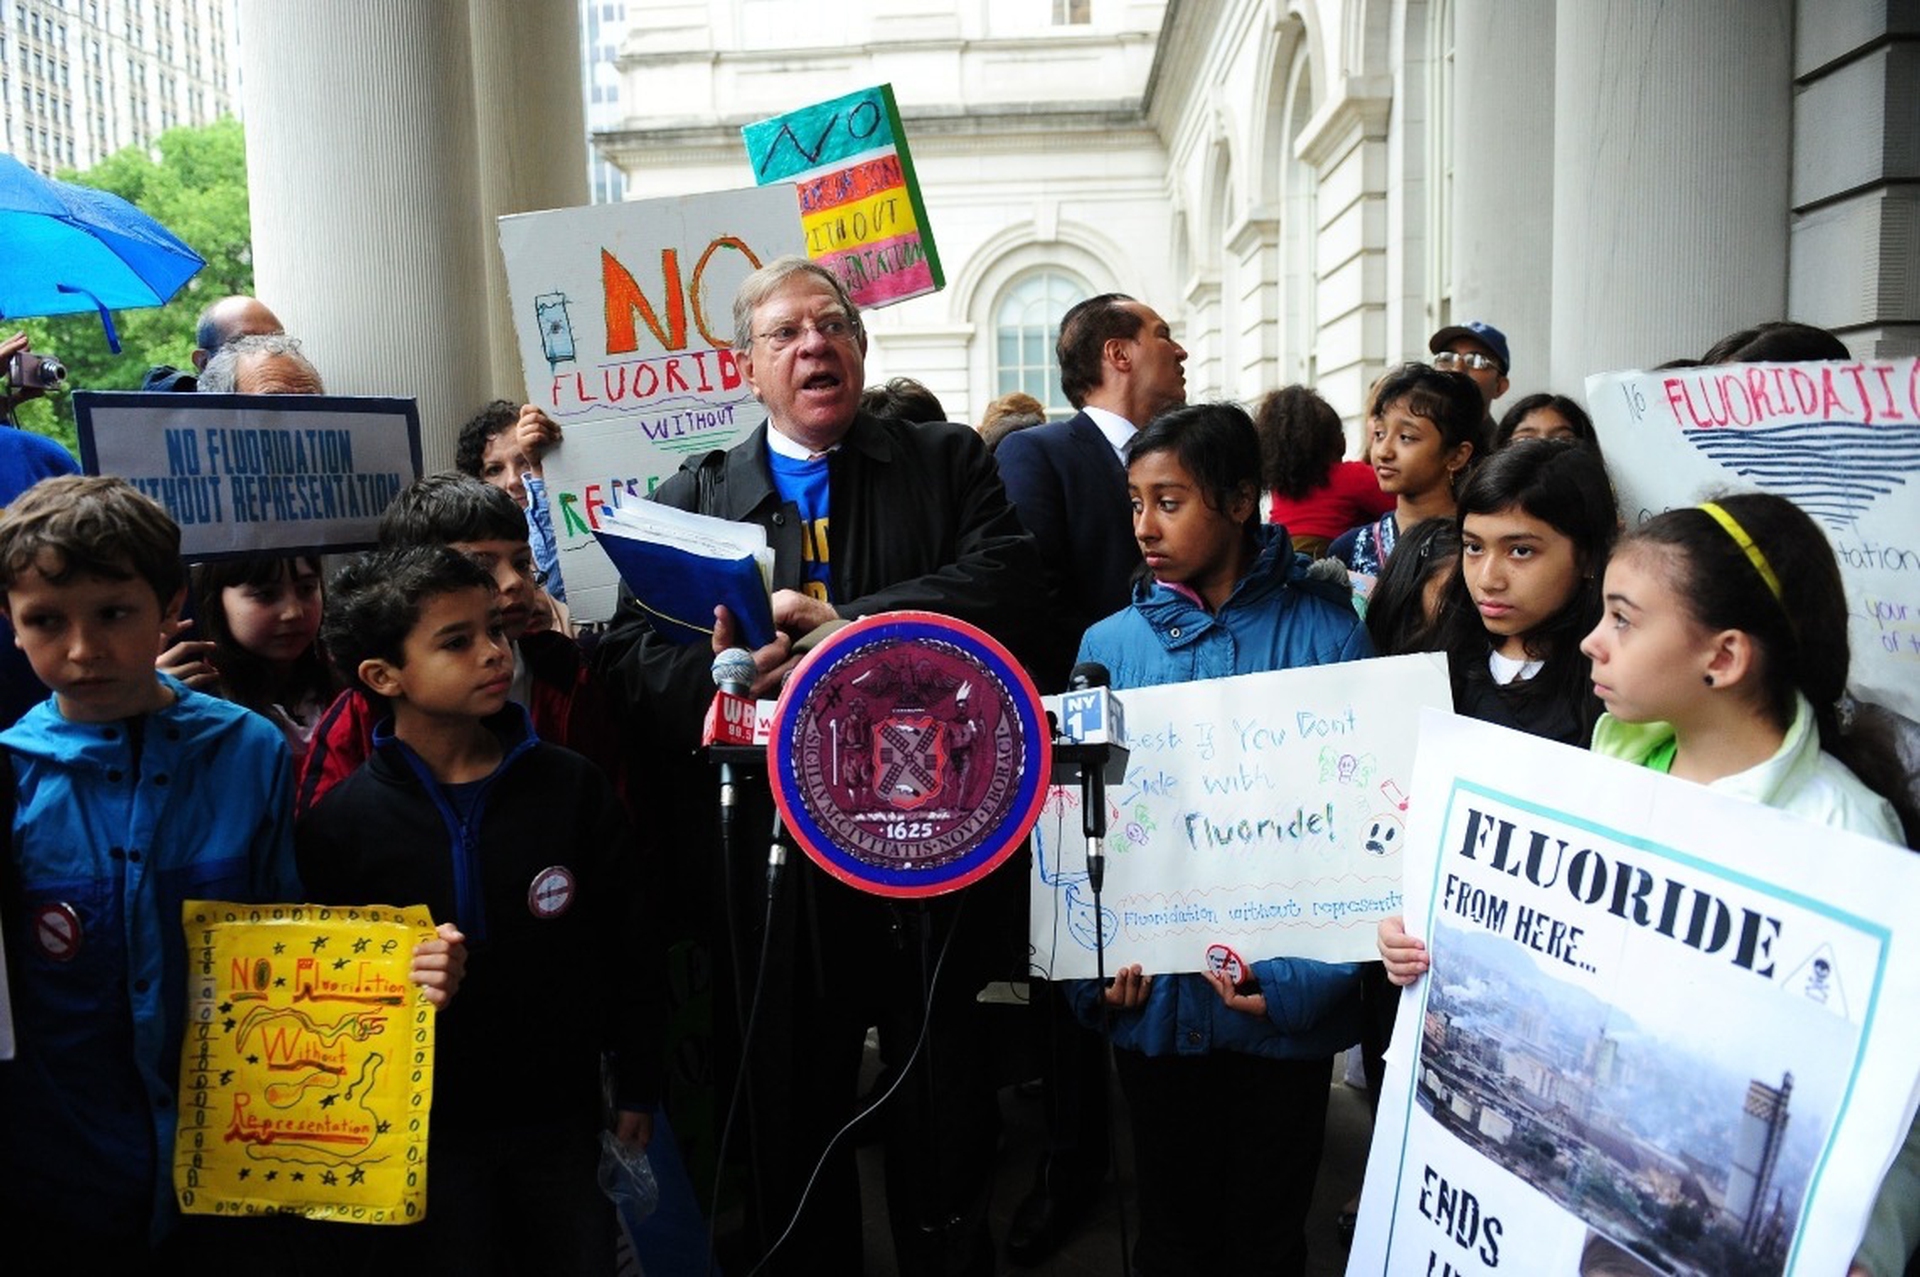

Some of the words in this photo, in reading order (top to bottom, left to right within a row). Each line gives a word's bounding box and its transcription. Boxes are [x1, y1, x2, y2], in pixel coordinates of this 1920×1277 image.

[759, 101, 882, 178] NO
[804, 198, 897, 252] ITHOUT
[601, 236, 762, 356] NO
[641, 406, 735, 440] WITHOUT
[165, 428, 198, 477] NO
[206, 428, 353, 475] FLUORIDATION
[1864, 599, 1909, 631] your
[1067, 695, 1097, 712] NY
[1067, 712, 1083, 742] 1
[804, 732, 839, 820] SIGILLVM
[837, 818, 934, 857] CIVITATIS
[937, 814, 984, 850] NOVI
[983, 731, 1014, 817] EBORACI
[1202, 763, 1276, 795] with
[886, 822, 933, 840] 1625
[1229, 899, 1302, 921] without
[1459, 808, 1783, 979] FLUORIDE
[1443, 873, 1509, 934] FROM
[1513, 904, 1597, 974] HERE...
[231, 957, 272, 992] NO
[261, 1025, 348, 1064] Without
[229, 1092, 371, 1135] Representation
[1418, 1163, 1504, 1269] ENDS
